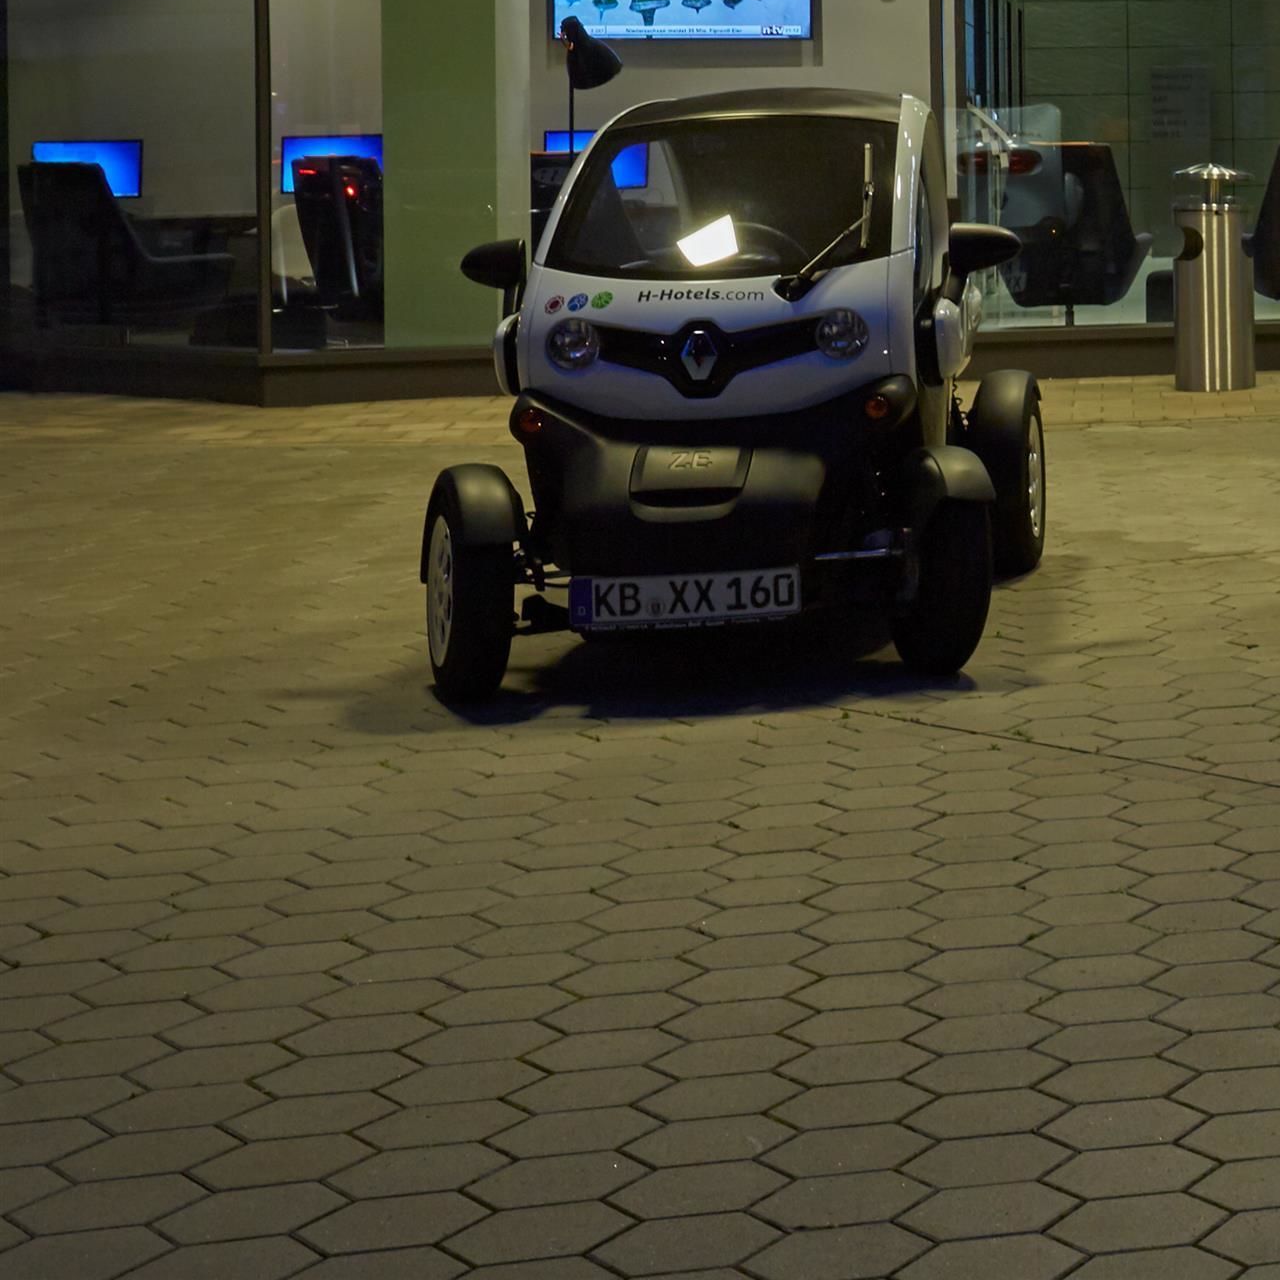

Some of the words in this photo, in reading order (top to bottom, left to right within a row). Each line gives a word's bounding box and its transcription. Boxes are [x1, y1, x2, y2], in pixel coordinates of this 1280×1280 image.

[638, 288, 764, 303] H-Hotels.com
[594, 582, 641, 617] KB
[668, 578, 716, 615] XX
[726, 573, 795, 612] 160
